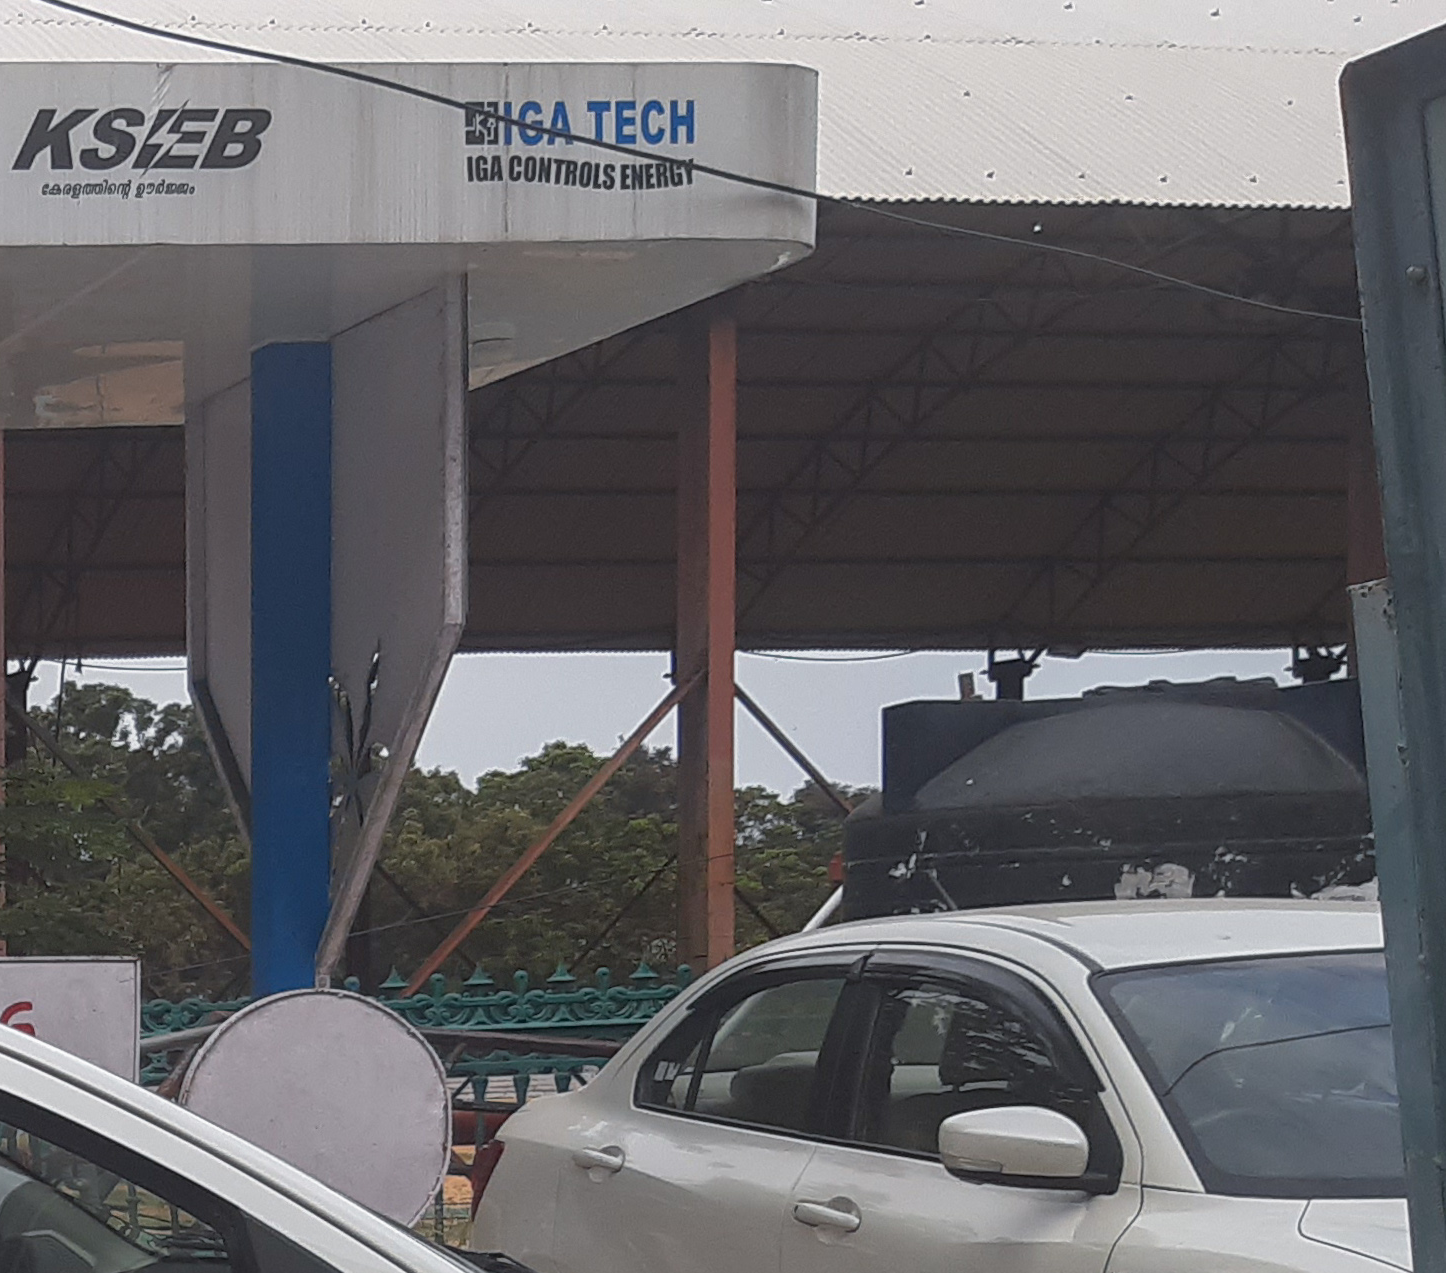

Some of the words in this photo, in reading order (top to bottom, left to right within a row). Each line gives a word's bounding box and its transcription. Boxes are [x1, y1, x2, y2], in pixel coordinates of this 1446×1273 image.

[11, 107, 272, 171] KSEB
[587, 99, 696, 145] TECH
[466, 155, 504, 183] IGA
[509, 155, 616, 191] CONTROLS
[620, 158, 695, 191] ENERGY
